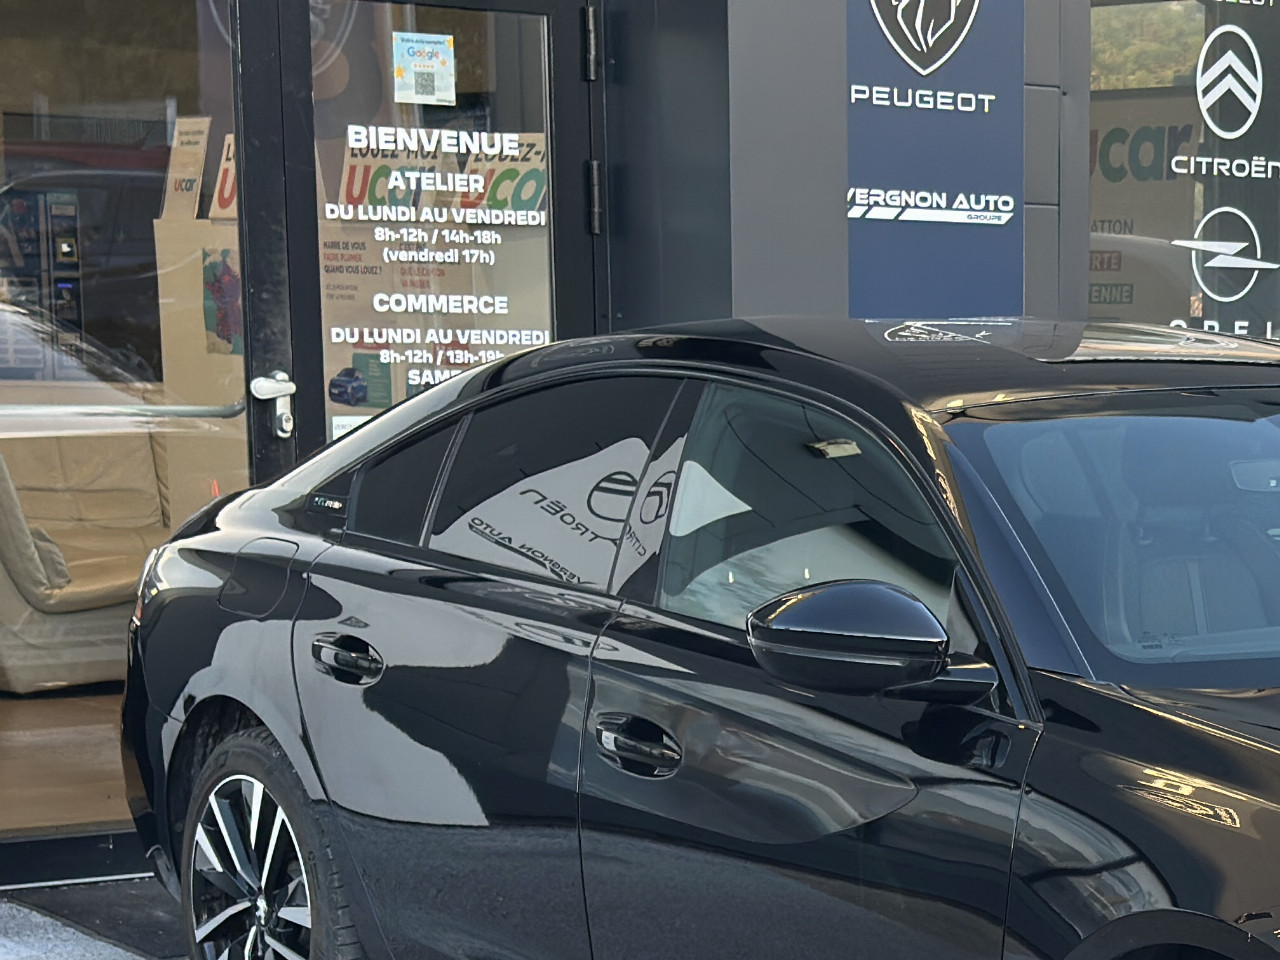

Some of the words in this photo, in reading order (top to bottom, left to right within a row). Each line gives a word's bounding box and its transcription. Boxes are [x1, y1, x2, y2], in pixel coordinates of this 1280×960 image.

[407, 46, 440, 60] Google
[850, 84, 996, 113] PEUGEOT
[347, 124, 520, 156] BIENVENUE
[387, 171, 485, 193] ATELIER
[952, 193, 1015, 212] AUTO
[325, 203, 354, 220] DU
[358, 204, 416, 221] LUNDI
[419, 207, 448, 223] AU
[451, 208, 547, 226] VENDREDI
[966, 213, 1003, 222] GROUPE
[374, 226, 429, 243] 8h-12h
[431, 229, 439, 245] /
[441, 229, 502, 245] 14h-18h
[461, 249, 496, 266] 17h)
[360, 265, 379, 276] LOUEZ
[372, 292, 509, 314] COMMERCE
[330, 327, 359, 343] DU
[362, 328, 421, 344] LUNDI
[425, 329, 453, 345] AU
[456, 329, 549, 346] VENDREDI
[379, 349, 434, 364] 8h-12h
